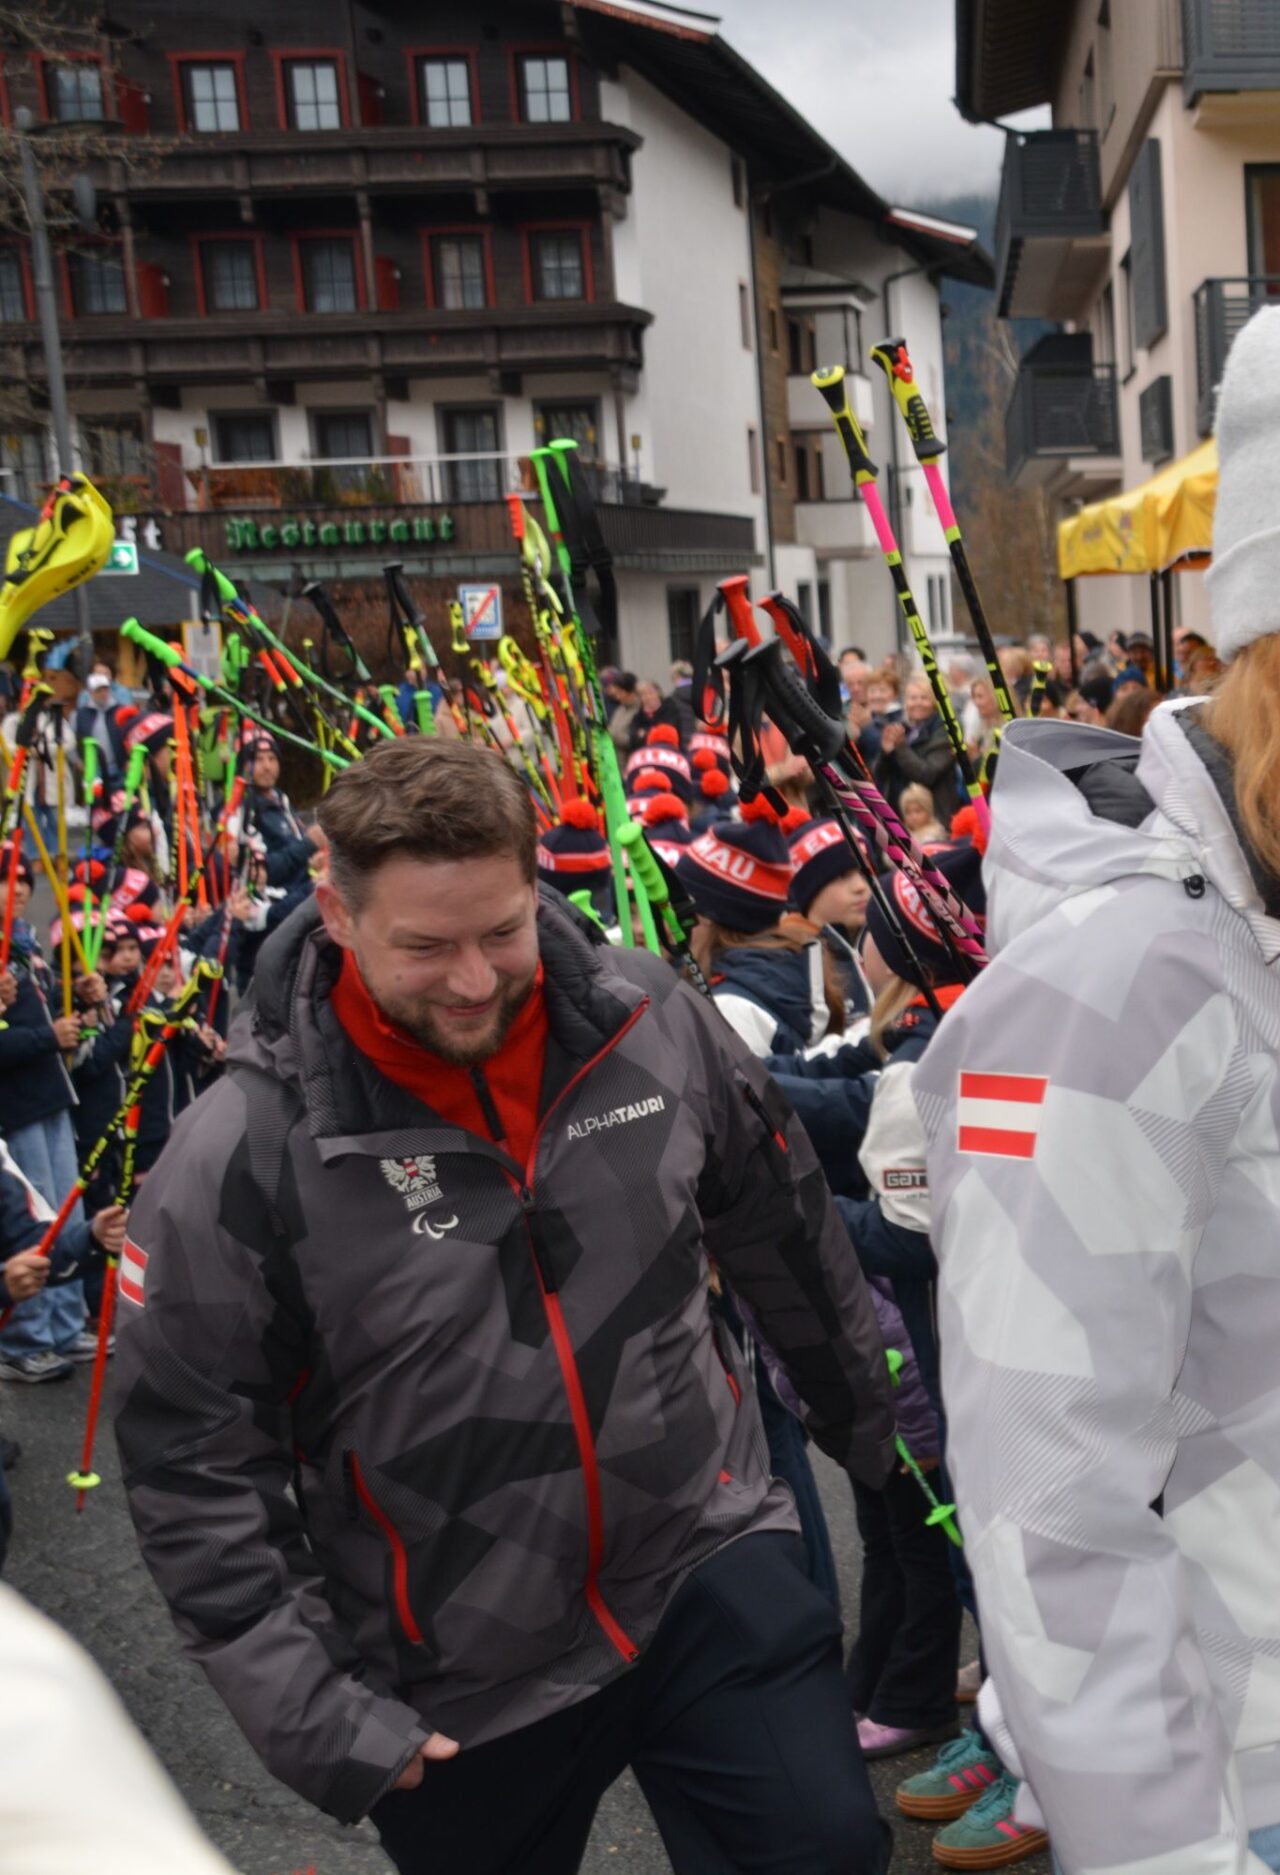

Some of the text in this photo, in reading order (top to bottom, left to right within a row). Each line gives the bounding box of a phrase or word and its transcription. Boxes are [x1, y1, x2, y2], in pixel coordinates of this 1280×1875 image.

[226, 513, 454, 549] Restaurant
[567, 1095, 665, 1141] ALPHATAURI
[406, 1185, 442, 1209] AUSTRIA
